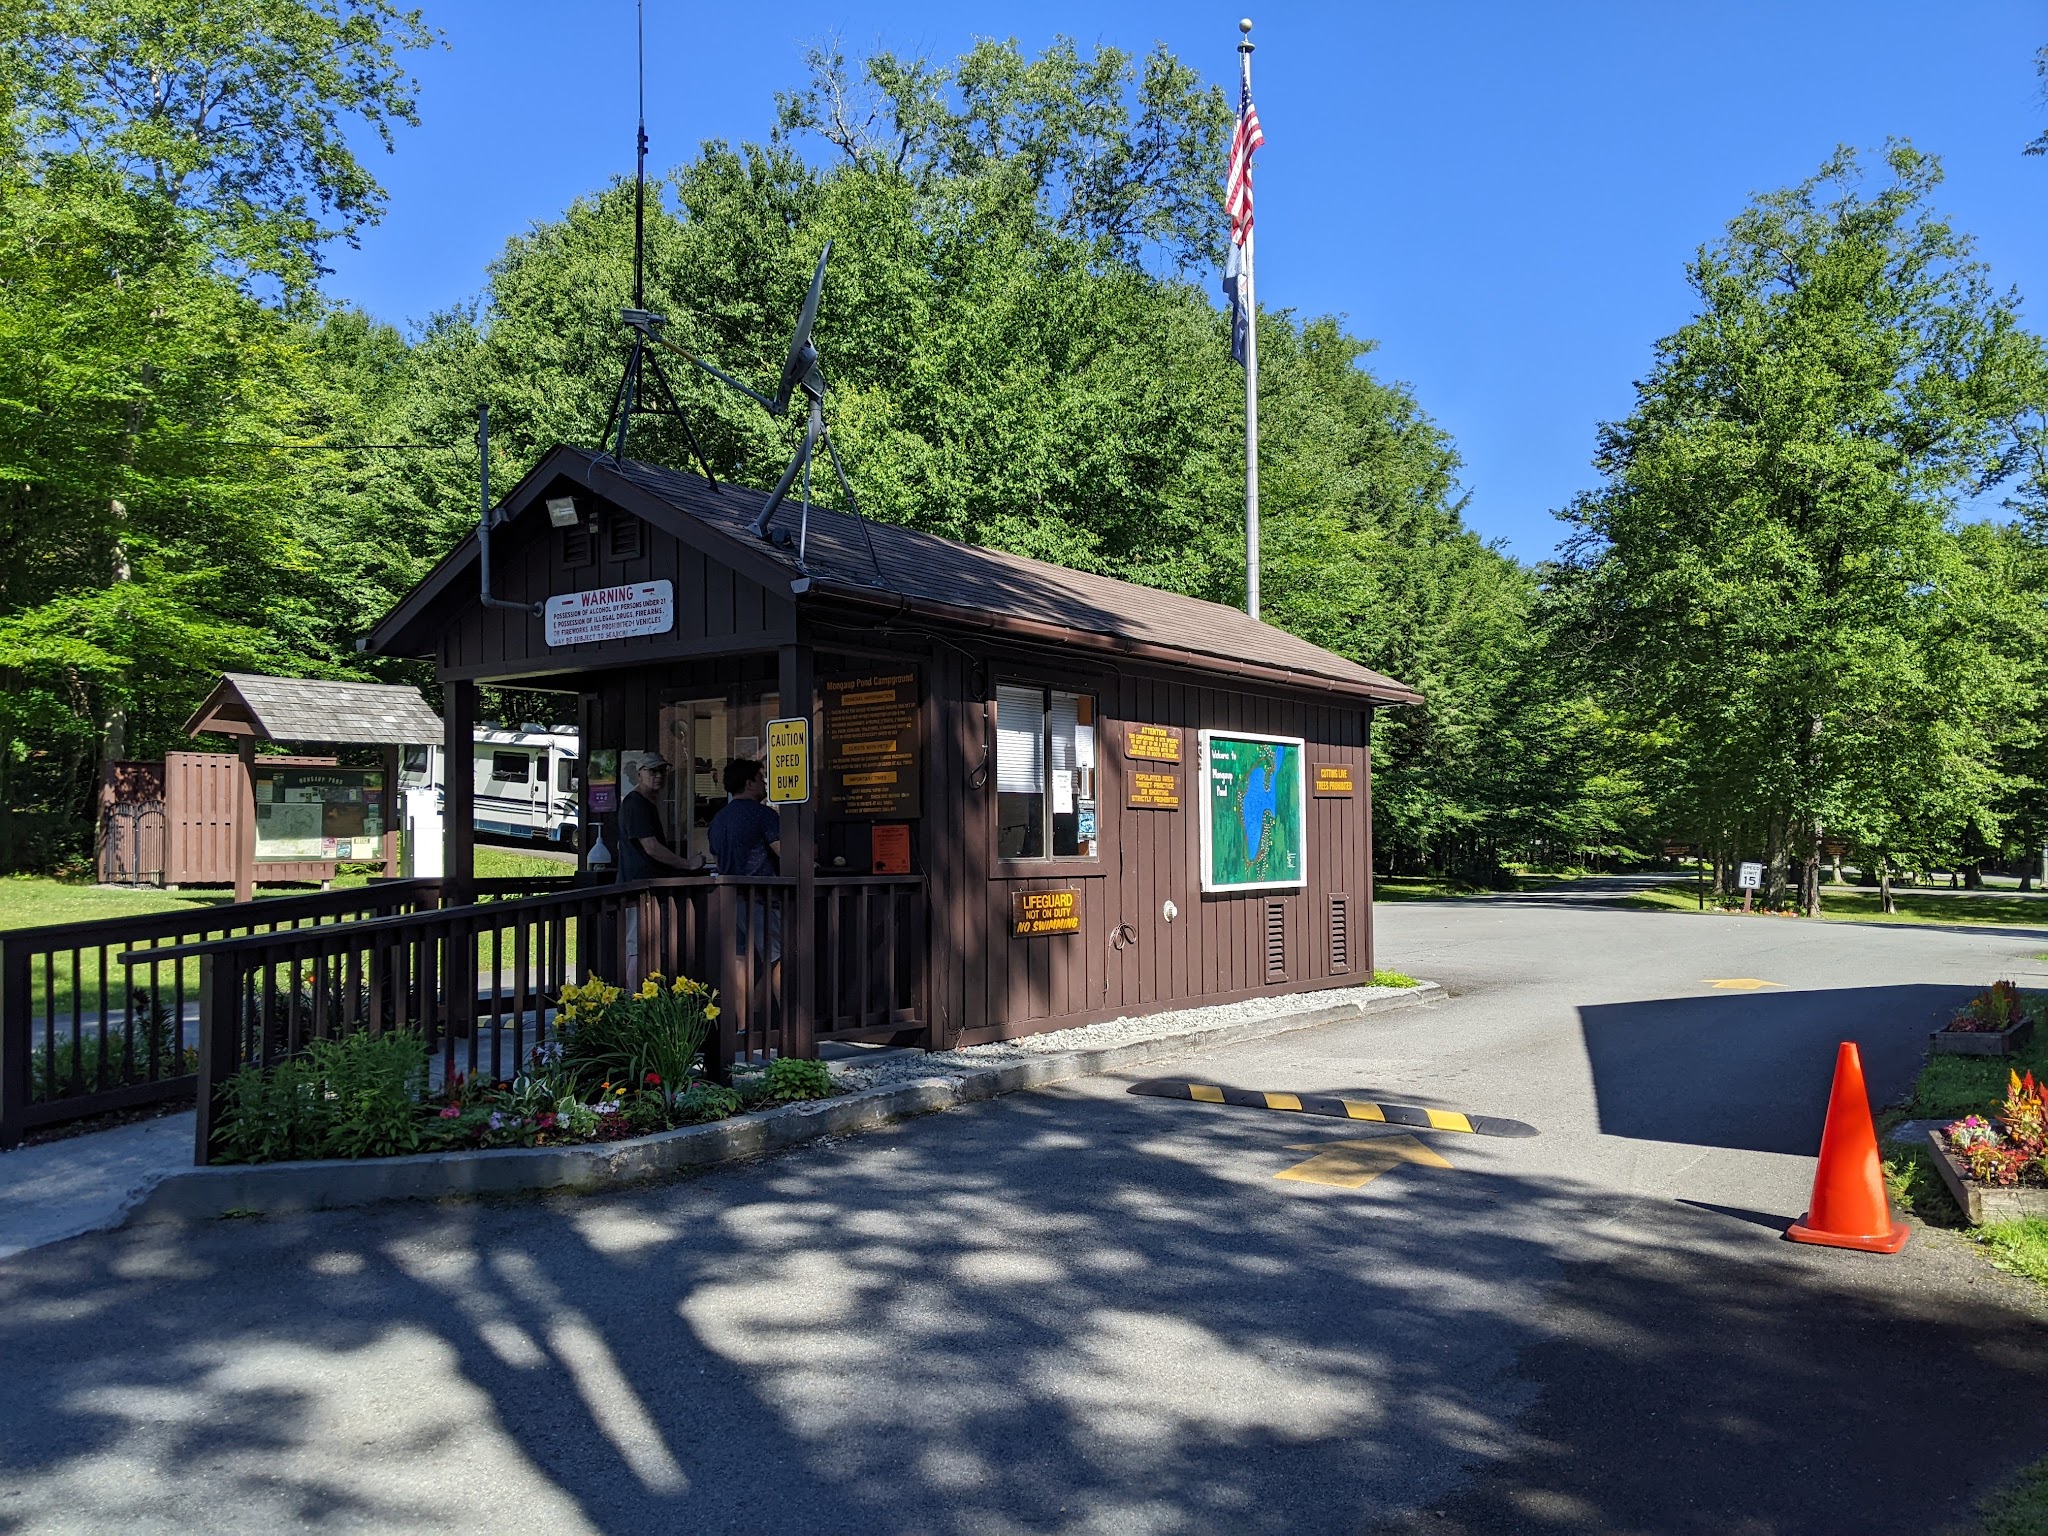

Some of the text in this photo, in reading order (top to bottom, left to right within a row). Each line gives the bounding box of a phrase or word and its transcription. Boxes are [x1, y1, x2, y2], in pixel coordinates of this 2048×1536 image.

[582, 587, 633, 606] WARNING
[554, 611, 580, 620] POSSESSION
[590, 606, 612, 614] ALCOHOL
[621, 602, 642, 610] PERSONS
[558, 618, 585, 628] POSSESSION
[594, 614, 615, 623] ILLEGAL
[561, 627, 588, 635] FIREWORKS
[636, 617, 661, 626] VEHICLES
[574, 633, 595, 642] SUBJECT
[826, 673, 914, 691] Mongaup Pond Campground
[1142, 727, 1166, 736] ATTENTION
[771, 732, 804, 747] CAUTION
[776, 754, 799, 768] SPEED
[1211, 749, 1237, 760] Welcome to
[1321, 769, 1347, 778] CUTTING LIVE
[778, 775, 798, 788] BUMP
[1316, 781, 1352, 790] TREES PROHIBITED
[1216, 785, 1227, 796] Pond
[1744, 876, 1756, 885] 15
[1023, 894, 1072, 909] LIFEGUARD
[1026, 908, 1070, 919] NOT ON DUTY
[1017, 917, 1078, 933] NO SWIMMING
